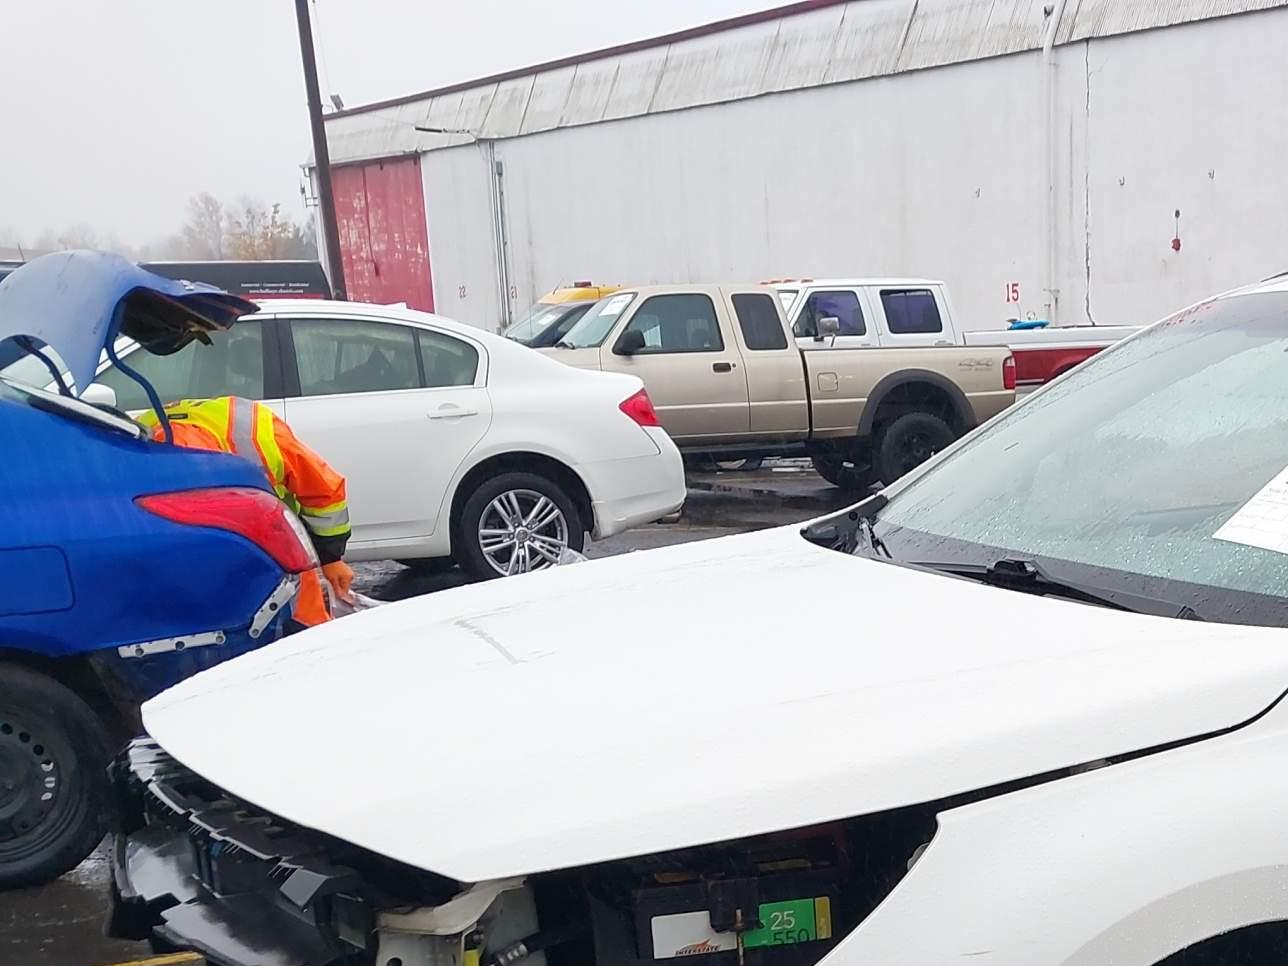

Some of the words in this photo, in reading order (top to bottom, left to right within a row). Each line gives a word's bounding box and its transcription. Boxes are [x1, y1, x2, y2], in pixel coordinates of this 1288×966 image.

[1006, 282, 1019, 302] 15
[769, 910, 796, 931] 25
[772, 928, 810, 945] 550
